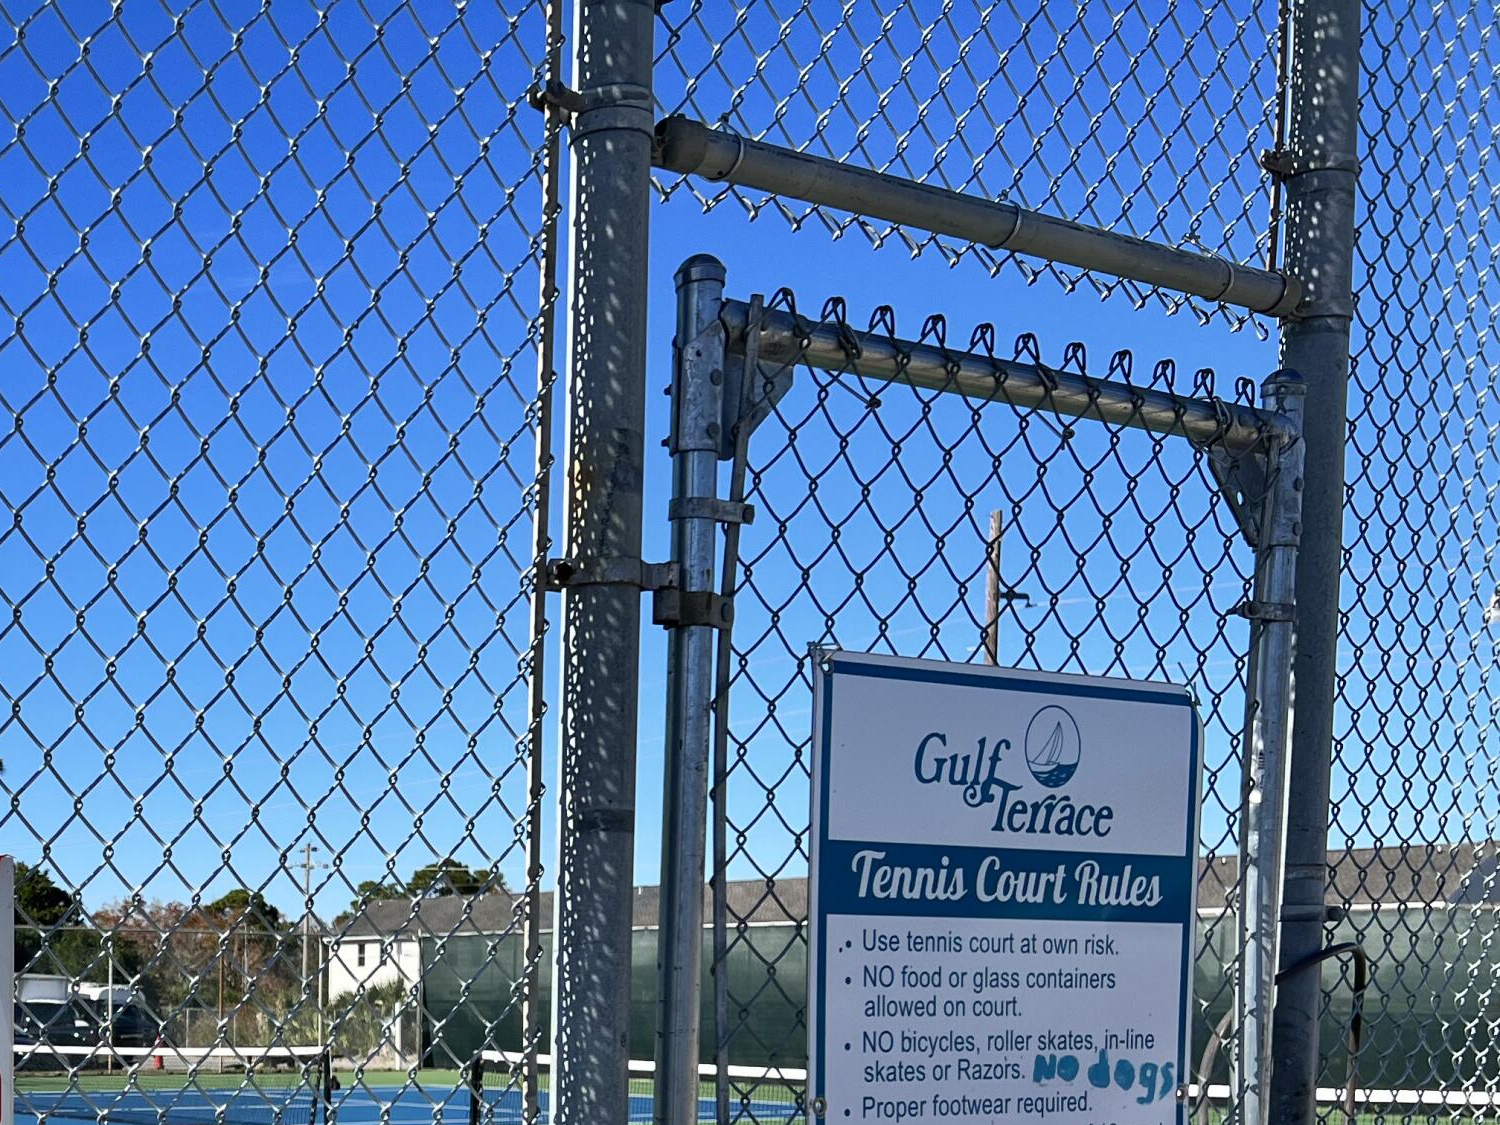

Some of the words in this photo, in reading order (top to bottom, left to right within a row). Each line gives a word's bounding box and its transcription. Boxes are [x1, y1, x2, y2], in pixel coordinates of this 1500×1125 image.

[914, 733, 1011, 807] Gulf
[982, 780, 1114, 837] Terrace
[852, 850, 968, 899] Tennis
[976, 856, 1067, 904] Court
[1075, 860, 1163, 906] Rules
[862, 929, 899, 952] Use
[907, 930, 962, 953] tennis
[969, 934, 1014, 954] court
[1020, 935, 1037, 953] at
[1043, 938, 1078, 955] own
[1084, 934, 1119, 955] risk.
[863, 965, 894, 988] NO
[901, 965, 942, 988] food
[949, 971, 967, 988] or
[973, 967, 1019, 993] glass
[1026, 968, 1116, 989] containers
[864, 996, 936, 1017] allowed
[944, 1000, 965, 1017] on
[973, 998, 1022, 1017] court.
[863, 1031, 894, 1053] NO
[901, 1030, 980, 1058] bicycles,
[987, 1030, 1032, 1051] roller
[1038, 1029, 1097, 1054] skates,
[1104, 1029, 1154, 1050] in-line
[864, 1060, 925, 1082] skates
[932, 1064, 951, 1081] or
[958, 1059, 1026, 1080] Razors.
[1088, 1049, 1174, 1104] dogs
[862, 1096, 926, 1123] Proper
[933, 1095, 1010, 1117] footwear
[1017, 1091, 1092, 1117] required.
